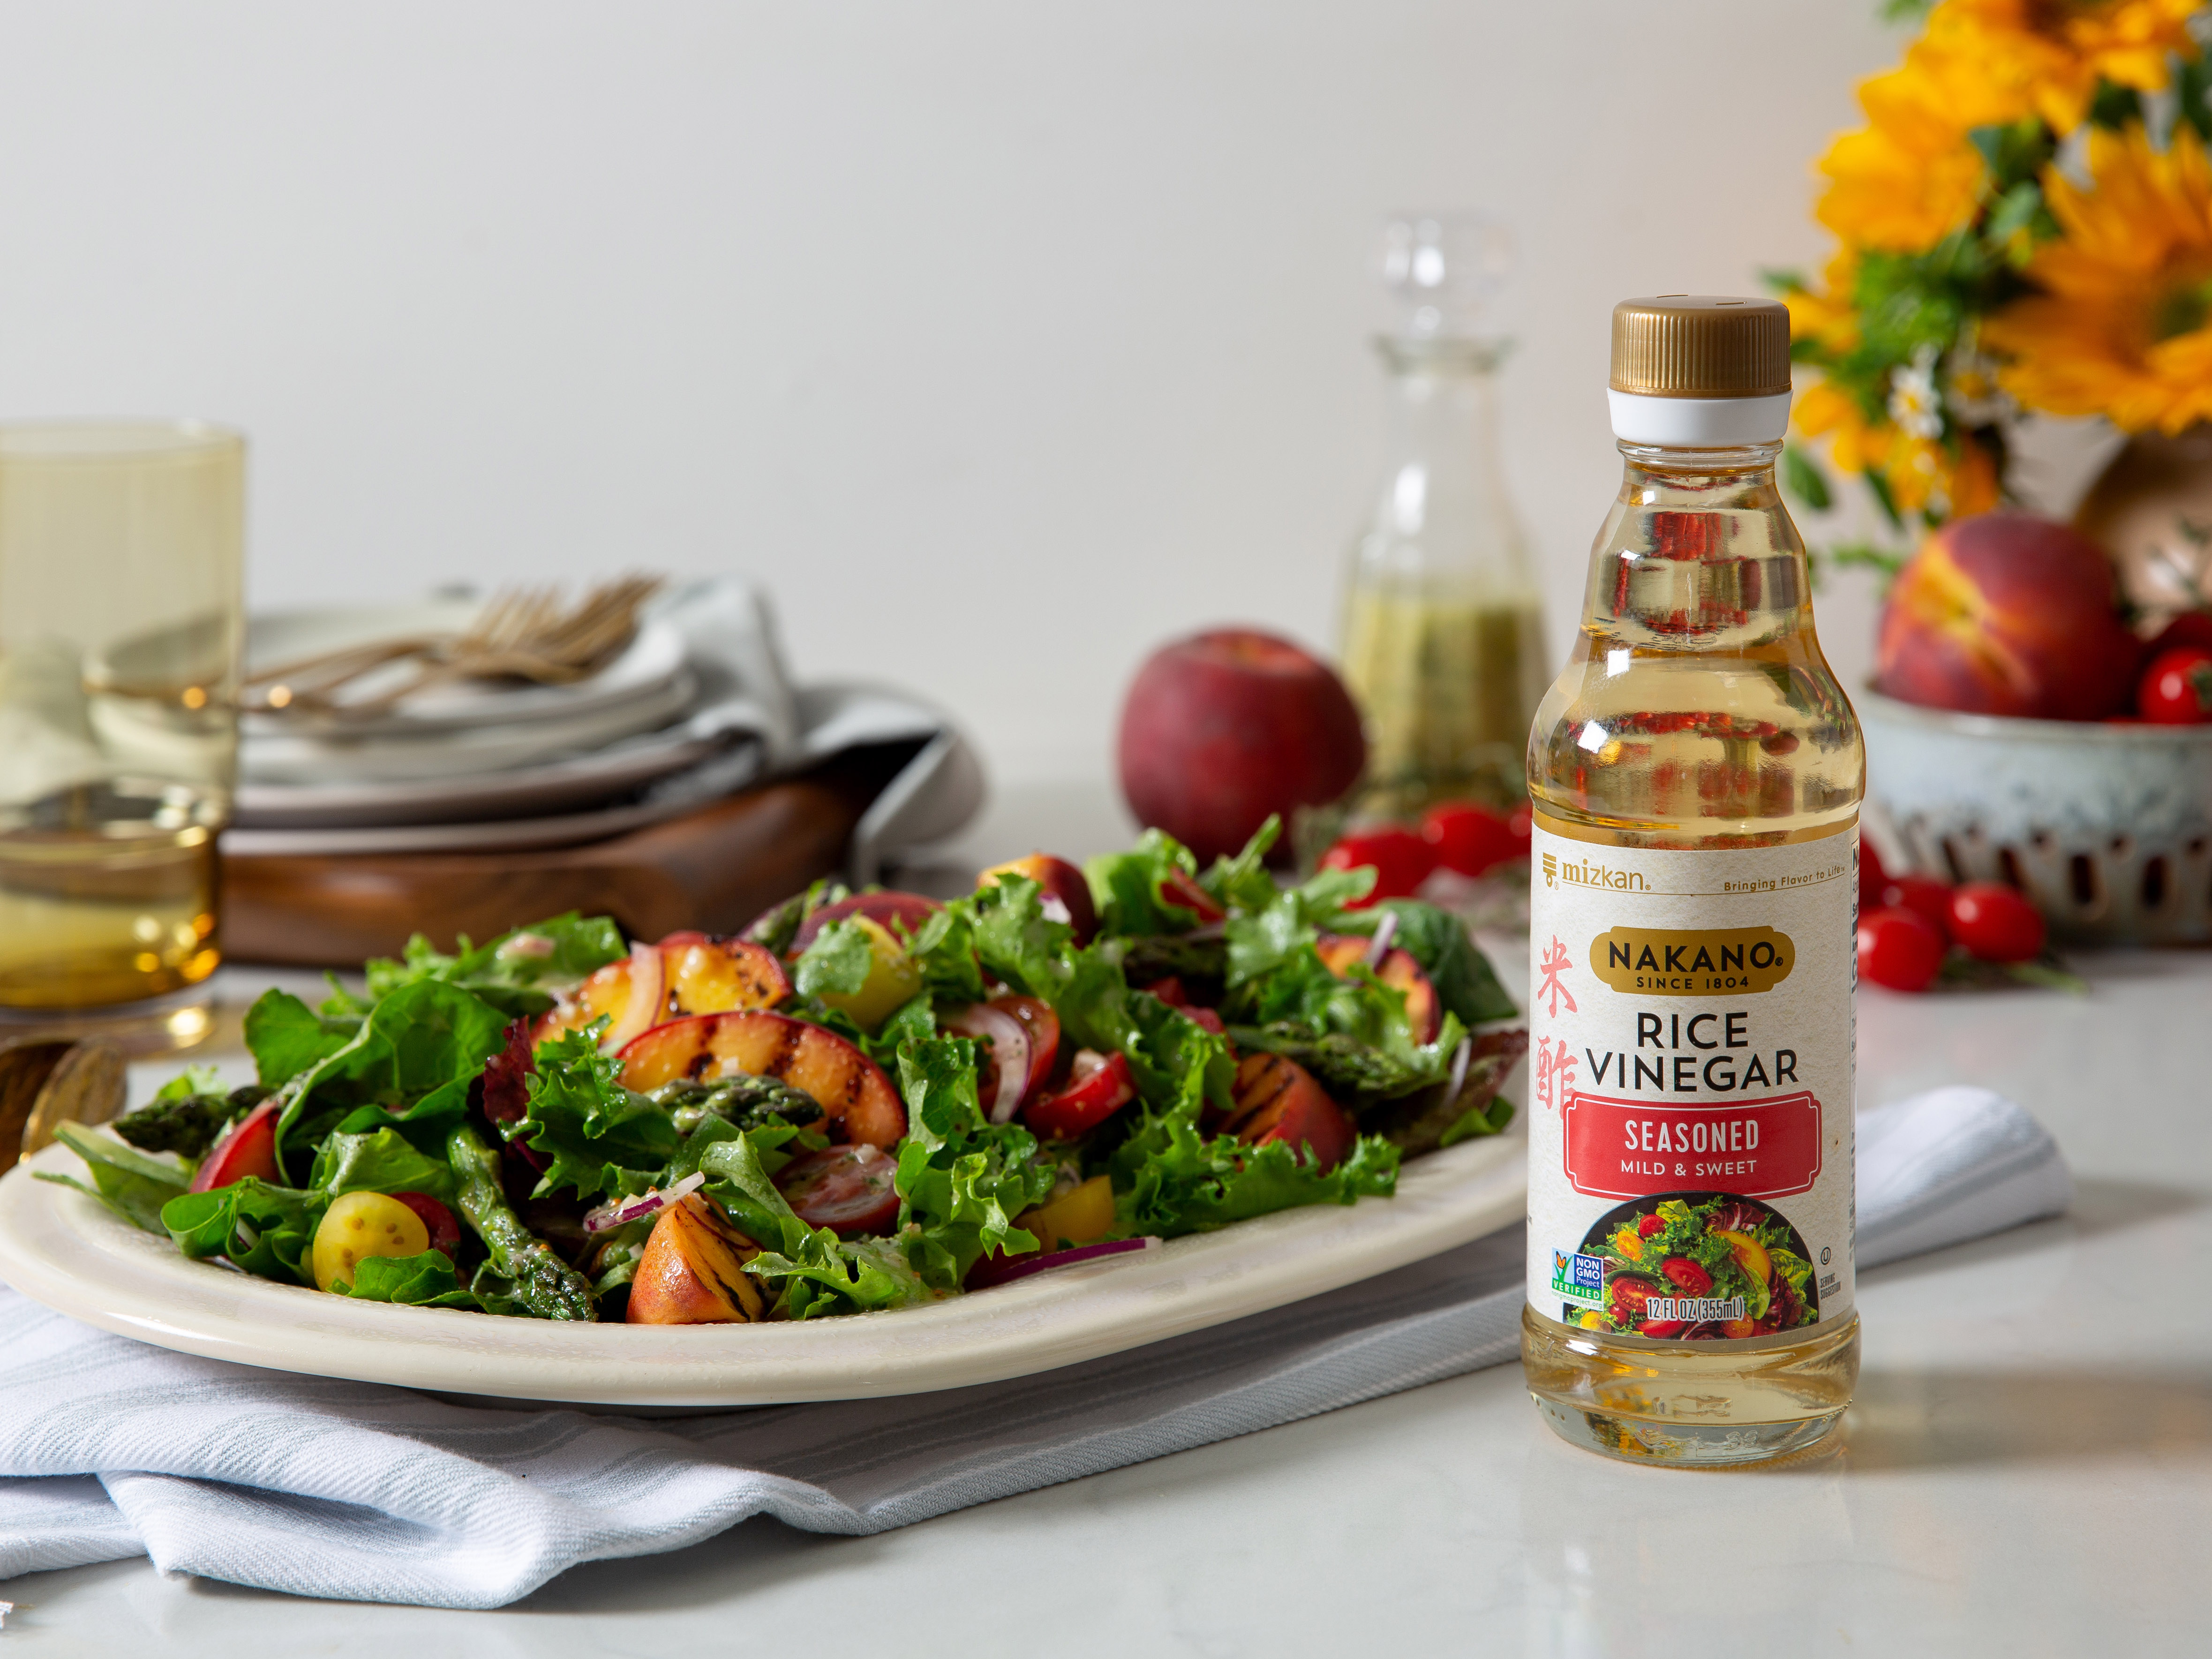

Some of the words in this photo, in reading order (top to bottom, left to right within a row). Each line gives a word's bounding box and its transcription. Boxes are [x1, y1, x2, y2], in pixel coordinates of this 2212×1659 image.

[1724, 880, 1776, 891] Bringing
[1781, 874, 1813, 886] Flavor
[1816, 871, 1825, 880] to
[1636, 976, 1693, 989] SINCE
[1706, 976, 1749, 989] 1804
[1637, 1011, 1749, 1050] RICE
[1585, 1048, 1800, 1093] VINEGAR
[1625, 1119, 1759, 1153] SEASONED
[1621, 1160, 1666, 1176] MILD
[1674, 1163, 1687, 1176] &
[1695, 1160, 1757, 1176] SWEET
[1576, 1257, 1600, 1271] NON
[1576, 1267, 1601, 1280] GMO
[1553, 1280, 1600, 1300] VERIFIED
[1576, 1276, 1600, 1288] Project
[1551, 1290, 1603, 1310] nongmoproject.org
[1648, 1298, 1660, 1319] 12
[1664, 1299, 1676, 1319] FL
[1680, 1300, 1694, 1320] OZ
[1698, 1296, 1742, 1321] (355mL)
